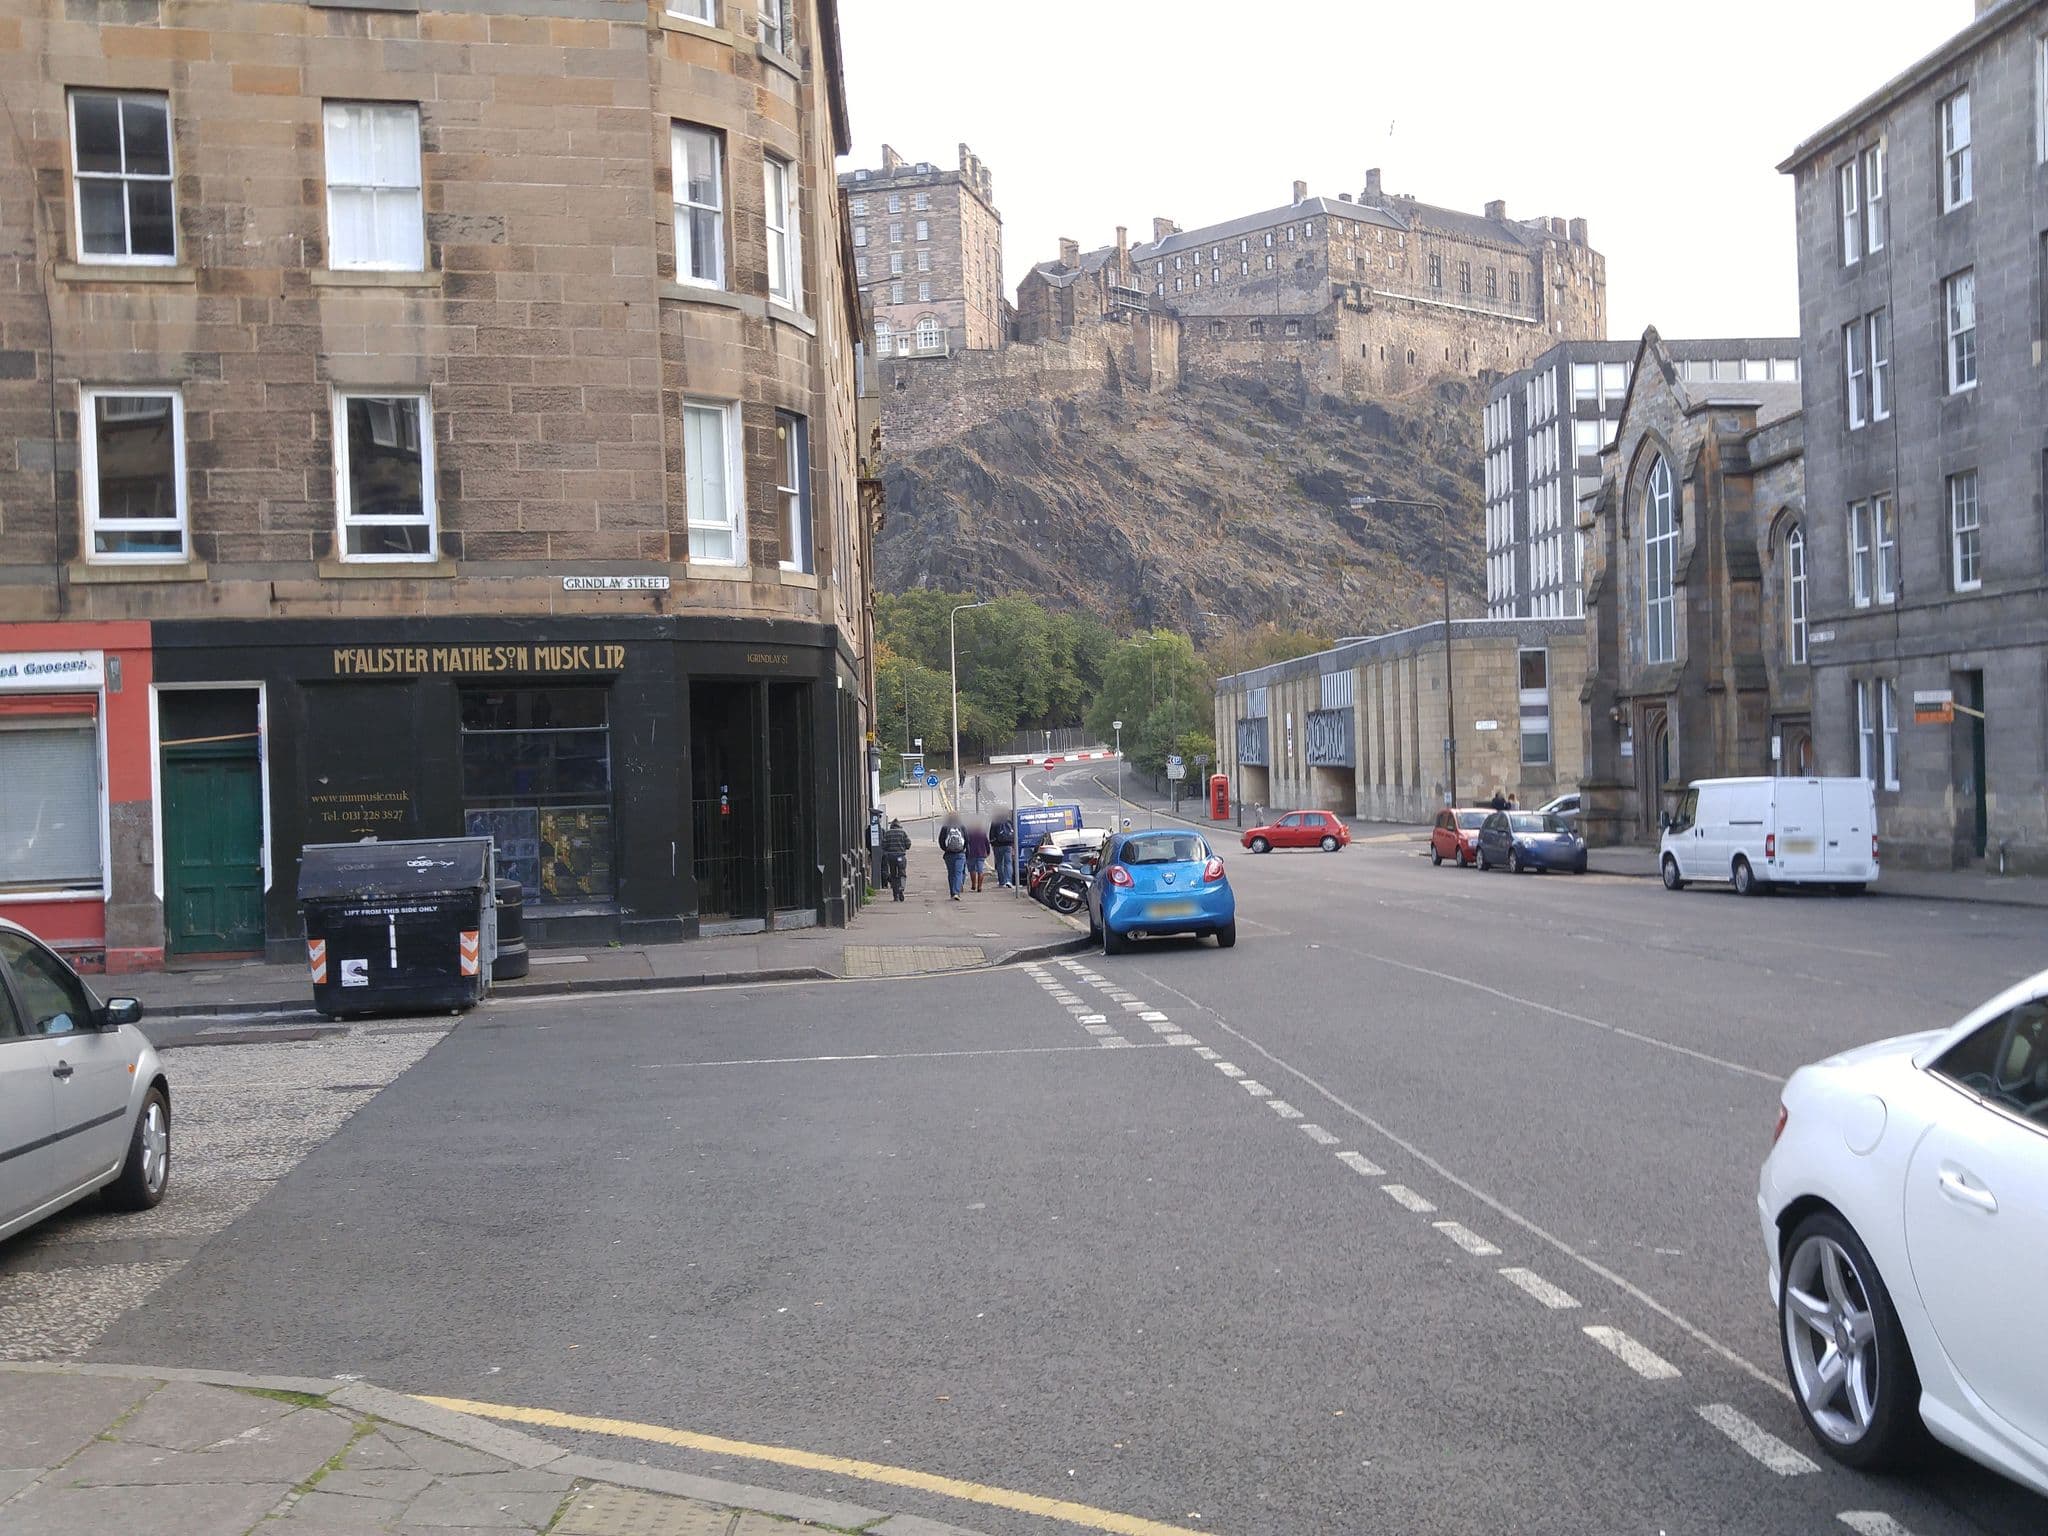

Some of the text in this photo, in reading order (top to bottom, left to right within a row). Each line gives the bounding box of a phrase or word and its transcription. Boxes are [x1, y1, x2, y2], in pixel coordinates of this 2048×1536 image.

[566, 577, 666, 588] GRINDLAY STREET
[433, 646, 528, 672] MATHESON
[535, 645, 590, 671] MUSIC
[750, 653, 780, 663] GRINDLAY
[342, 811, 360, 820] 0131
[362, 810, 379, 820] 228
[382, 810, 404, 822] 3827
